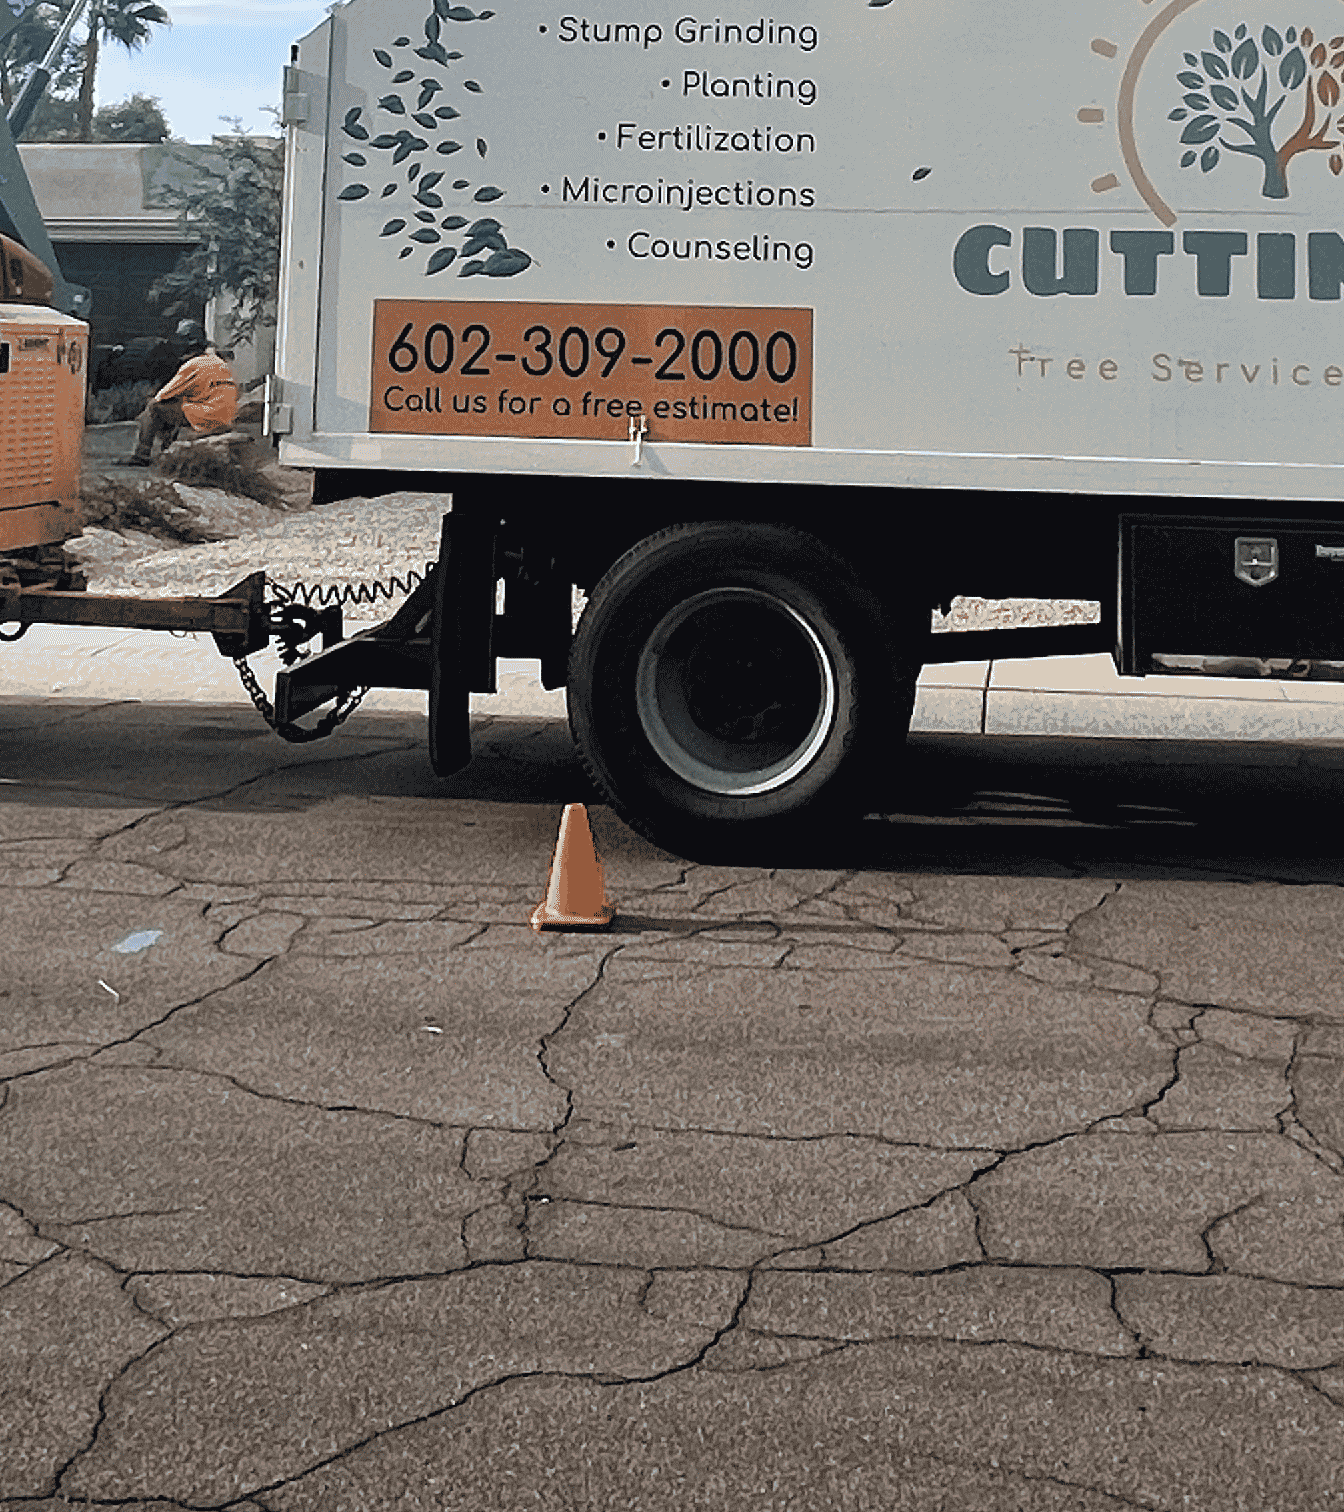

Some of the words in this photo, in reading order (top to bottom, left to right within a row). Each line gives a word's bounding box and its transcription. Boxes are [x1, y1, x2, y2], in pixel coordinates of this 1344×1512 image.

[558, 16, 664, 50] Stump
[674, 15, 818, 52] Grinding
[682, 70, 817, 106] Planting
[616, 122, 816, 153] Fertilization
[561, 176, 816, 212] Microinjections
[627, 231, 814, 270] Counseling
[388, 322, 797, 384] 602-309-2000
[384, 385, 442, 413] Call
[453, 394, 487, 414] us
[498, 389, 542, 415] for
[552, 397, 571, 416] a
[582, 391, 643, 418] free
[653, 395, 799, 423] estimate!
